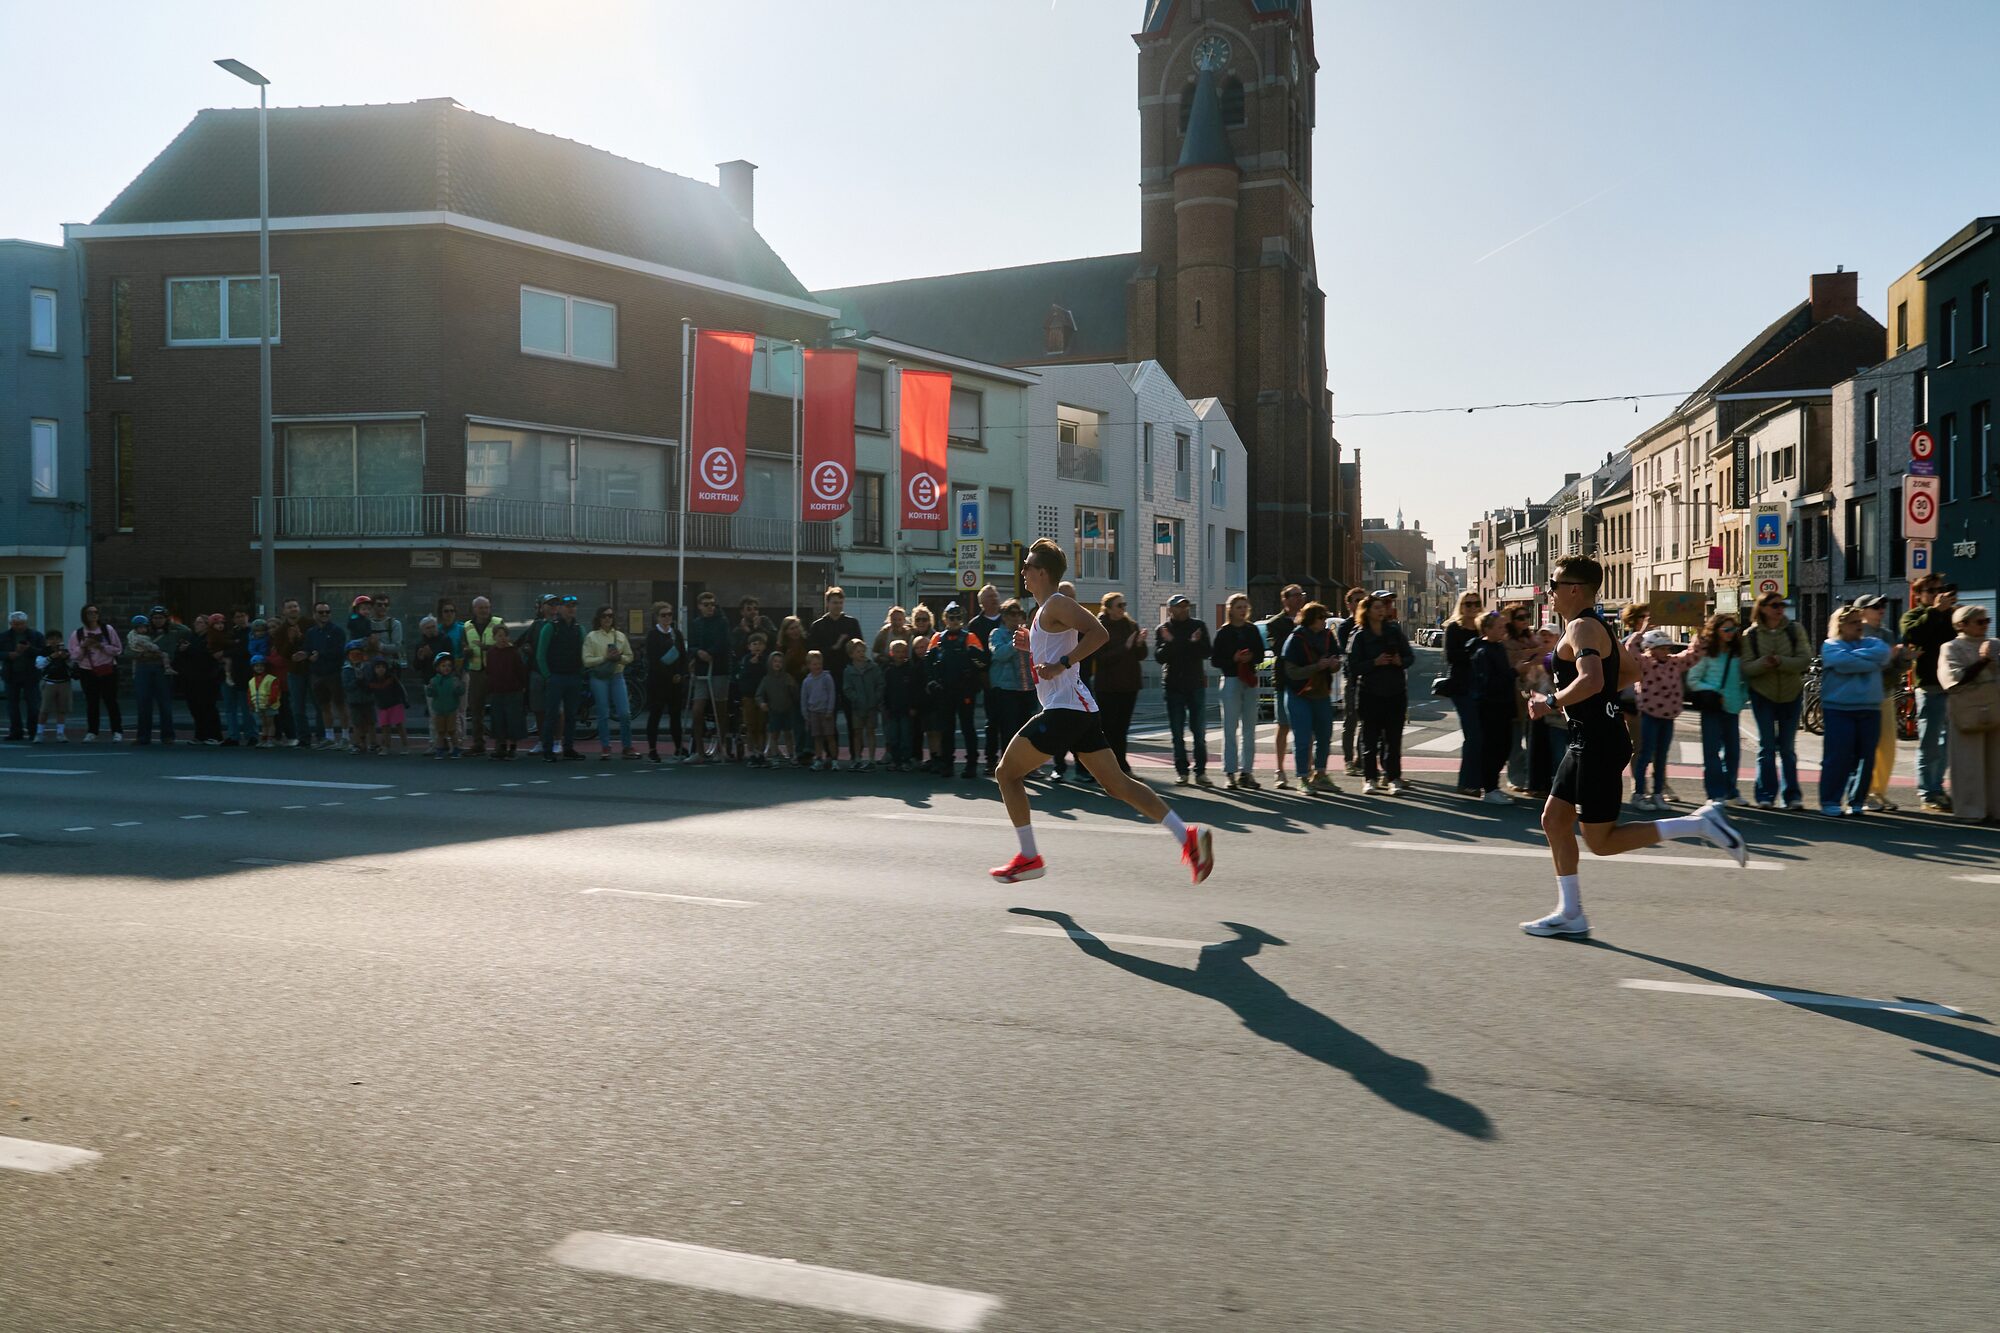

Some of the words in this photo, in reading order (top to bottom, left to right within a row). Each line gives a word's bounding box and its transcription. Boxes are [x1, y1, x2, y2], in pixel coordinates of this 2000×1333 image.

[1919, 439, 1926, 452] 5
[1737, 441, 1745, 479] INGELBEEN
[698, 491, 739, 502] KORTRIJK
[1737, 481, 1745, 506] OPTIEK
[1758, 504, 1778, 512] ZONE
[1916, 500, 1927, 510] 30
[1757, 554, 1779, 562] FIETS
[1916, 553, 1924, 566] P
